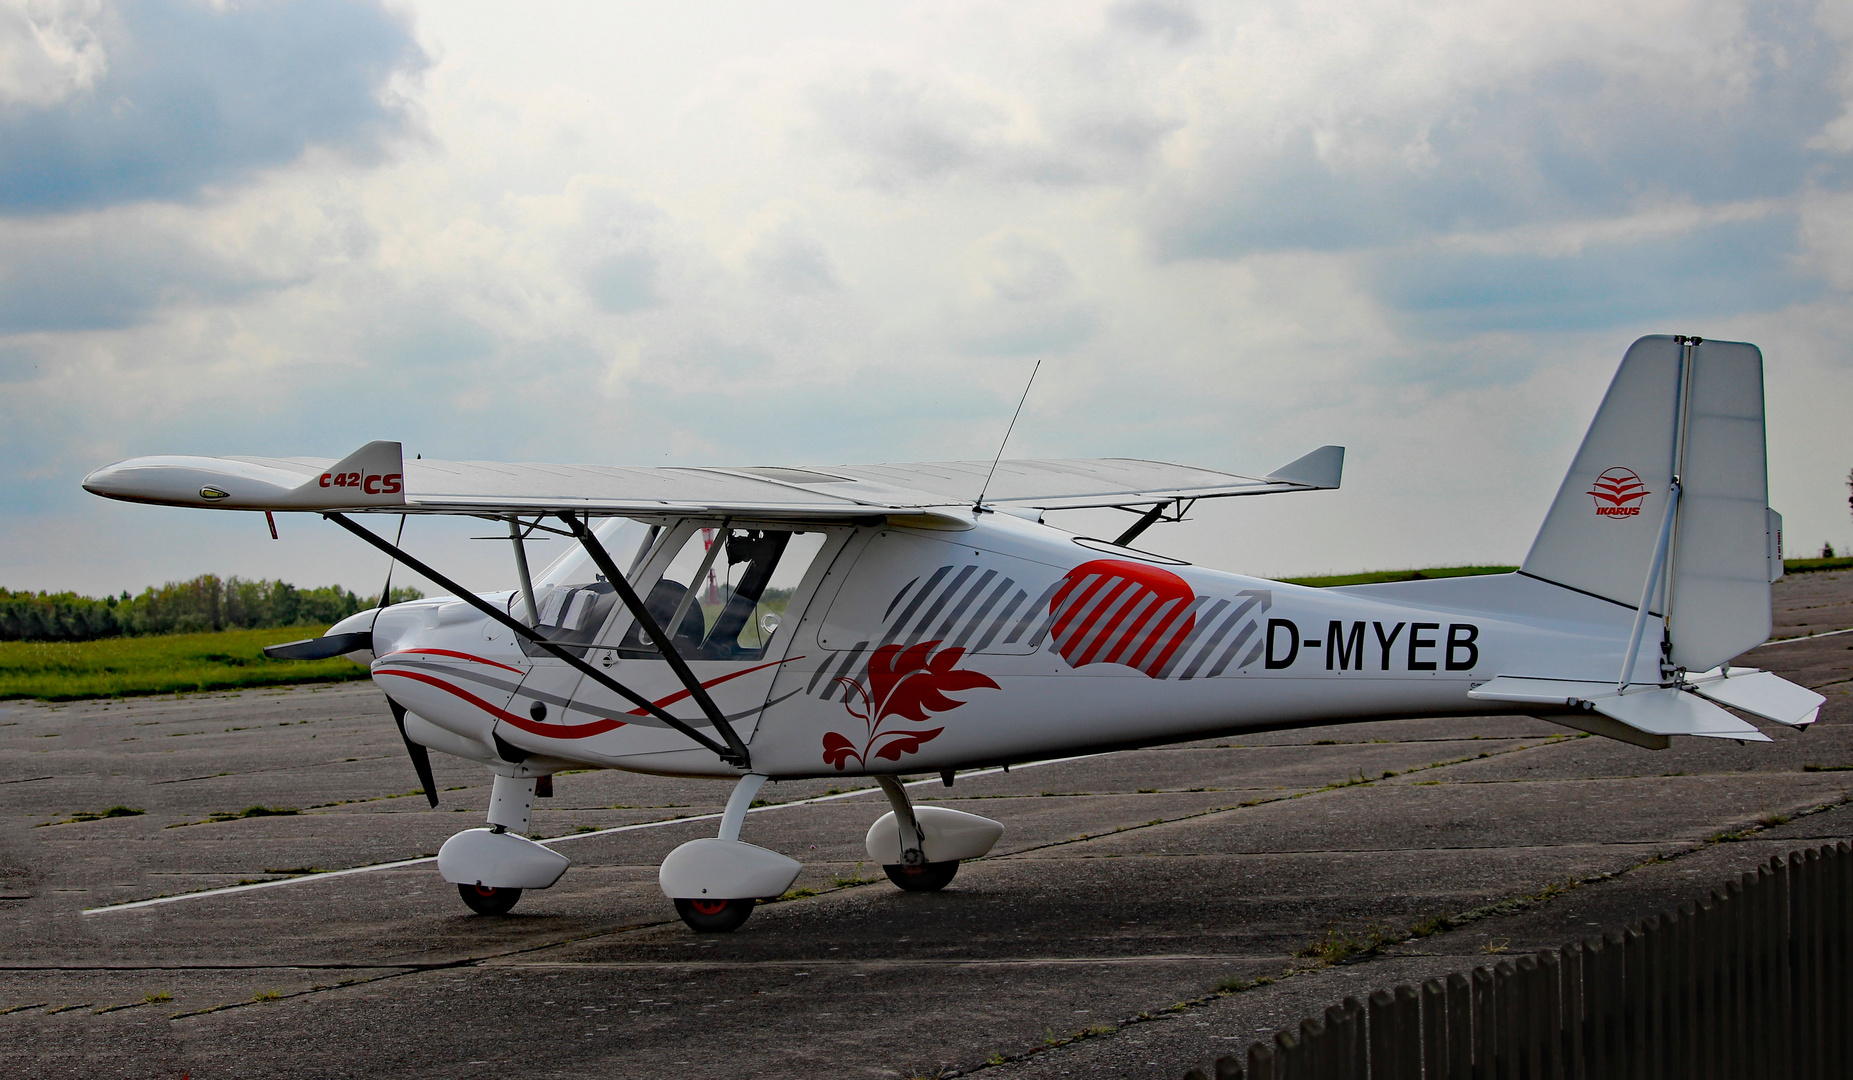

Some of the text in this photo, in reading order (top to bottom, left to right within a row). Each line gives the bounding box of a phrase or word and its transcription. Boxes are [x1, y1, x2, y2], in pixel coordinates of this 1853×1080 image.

[319, 473, 332, 488] C
[363, 473, 402, 495] CS
[1596, 507, 1641, 516] IKARUS
[1265, 618, 1479, 671] D-MYEB
